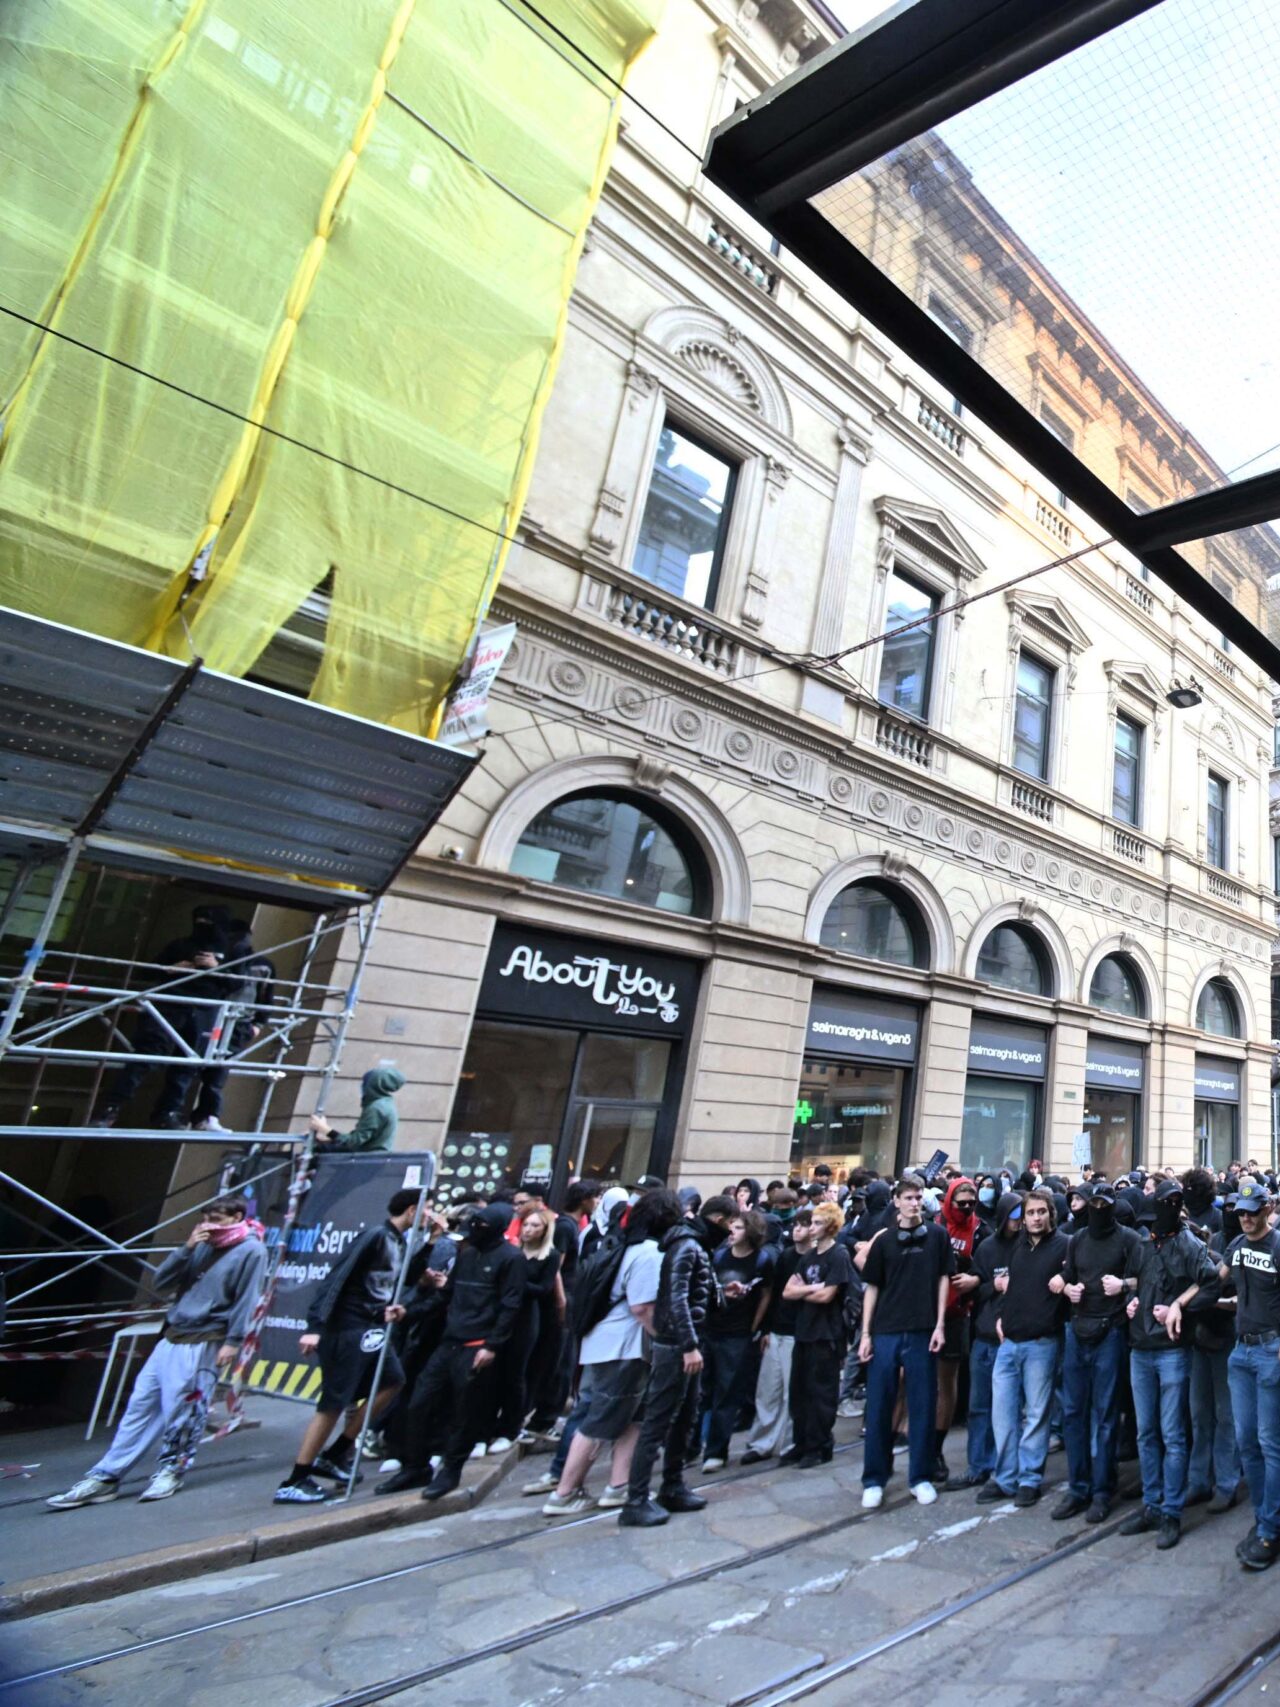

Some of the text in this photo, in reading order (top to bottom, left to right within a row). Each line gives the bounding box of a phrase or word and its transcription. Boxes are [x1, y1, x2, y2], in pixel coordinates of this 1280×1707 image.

[500, 945, 676, 1005] About You
[871, 1029, 879, 1041] &
